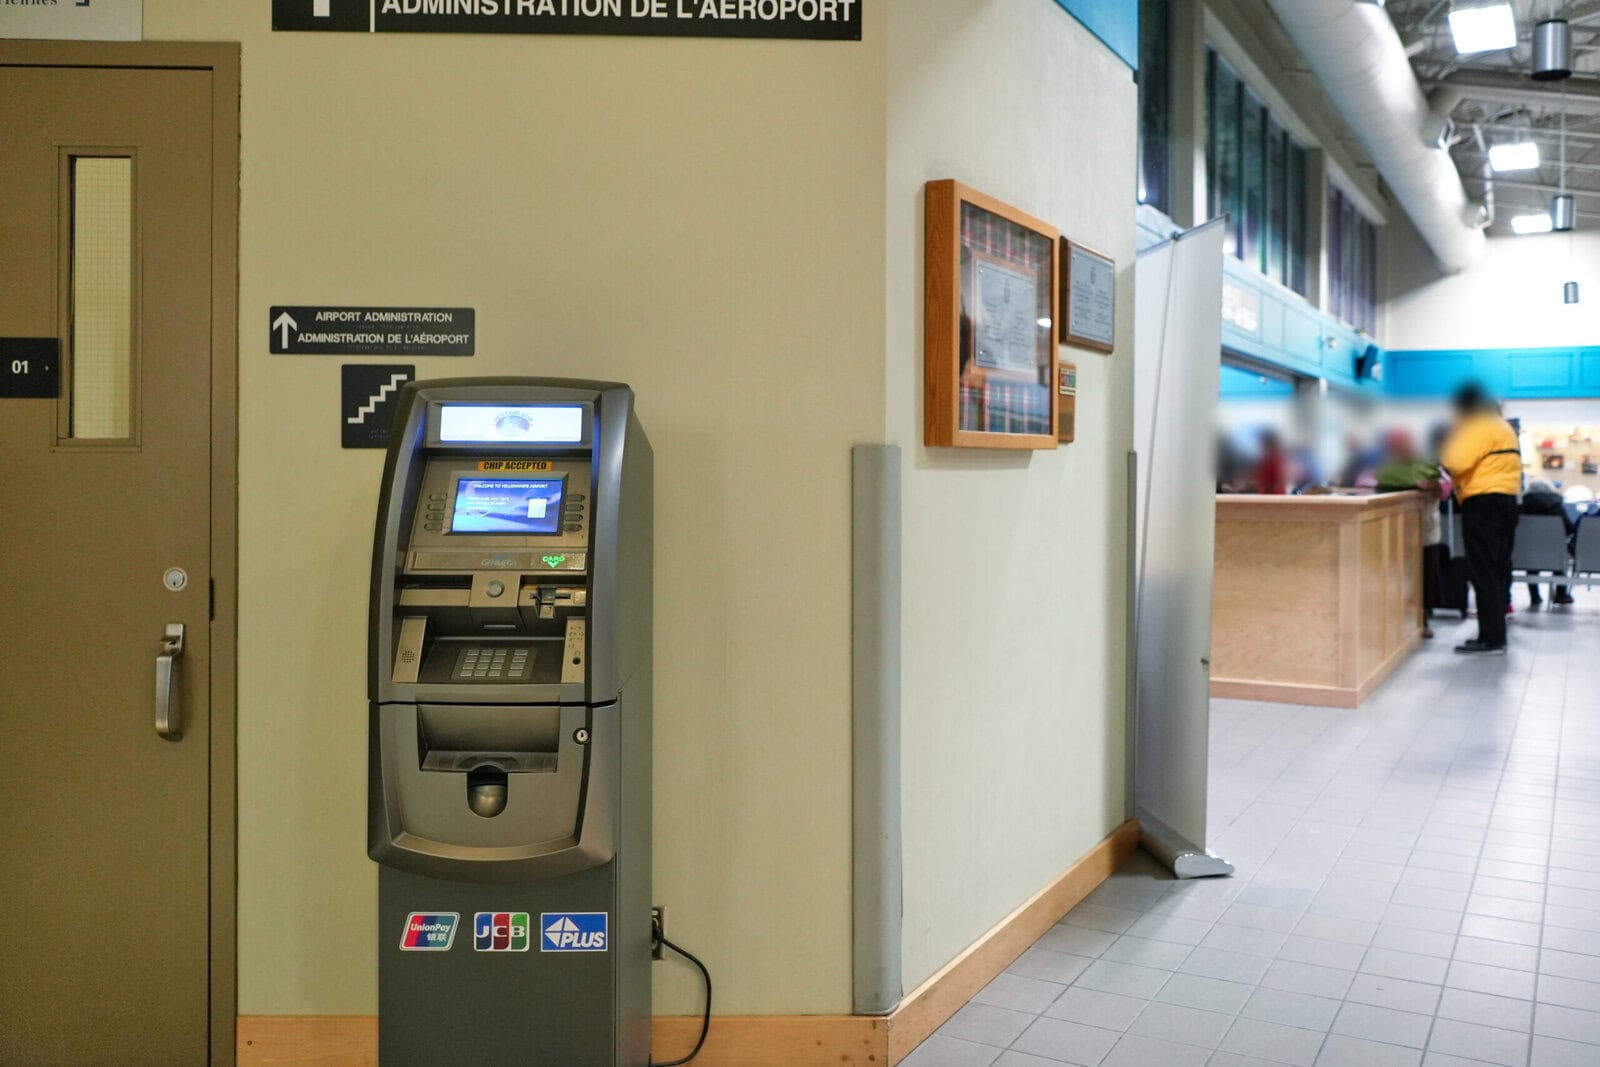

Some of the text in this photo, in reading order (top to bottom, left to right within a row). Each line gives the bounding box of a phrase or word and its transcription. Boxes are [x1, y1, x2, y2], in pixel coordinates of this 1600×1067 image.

[381, 0, 621, 17] ADMINISTRATION
[631, 0, 668, 18] DE
[315, 311, 453, 322] AIRPORT ADMINISTRATION
[297, 331, 470, 344] ADMINISTRATION DE L'AÉROPORT
[11, 360, 28, 374] 01
[484, 461, 547, 470] CHIP ACCEPTED
[410, 923, 451, 933] UnionPay
[476, 925, 525, 938] JCB
[560, 932, 604, 947] PLUS
